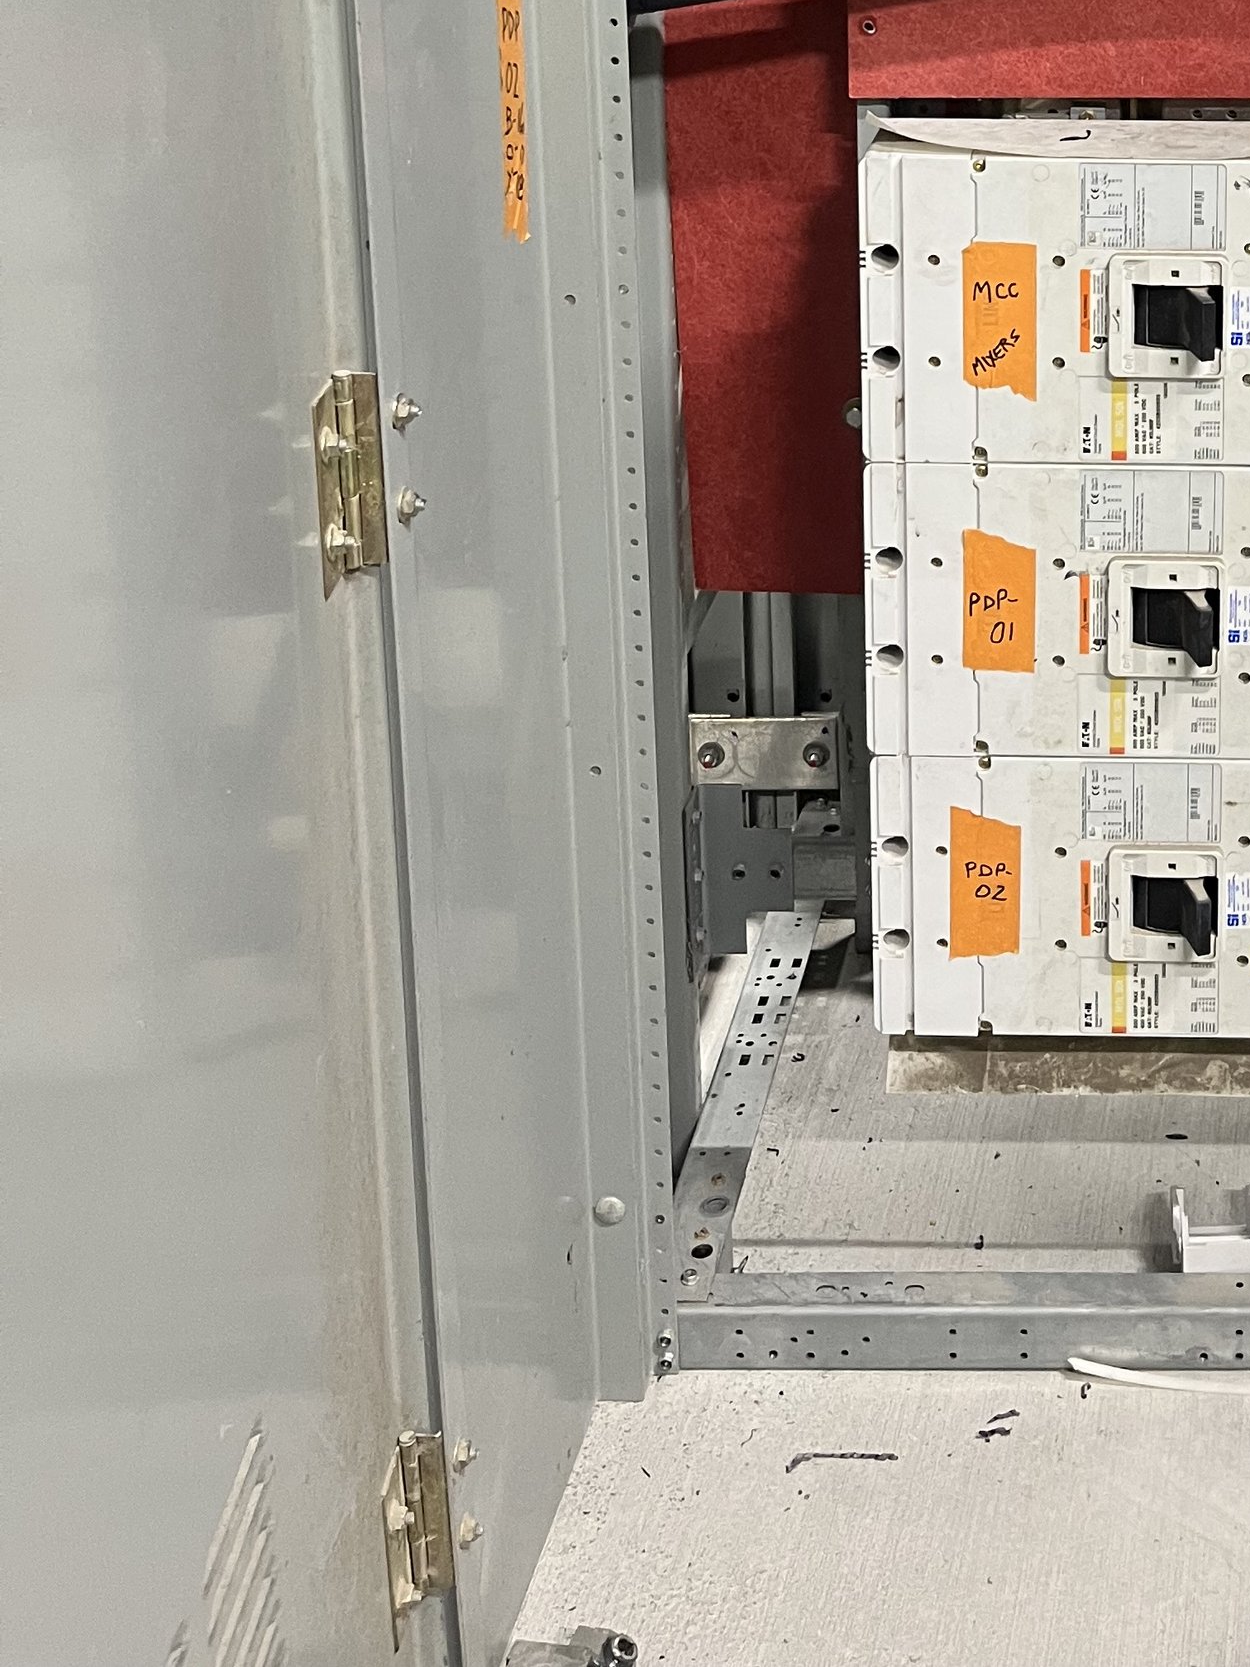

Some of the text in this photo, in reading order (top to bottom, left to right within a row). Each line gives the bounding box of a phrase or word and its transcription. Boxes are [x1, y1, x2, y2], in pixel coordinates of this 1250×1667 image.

[972, 280, 1019, 303] MCC
[971, 328, 1021, 376] MIXERS
[969, 588, 1019, 617] PDP-
[989, 621, 1014, 644] 01
[964, 861, 1012, 879] PDP-
[974, 884, 1007, 901] 02
